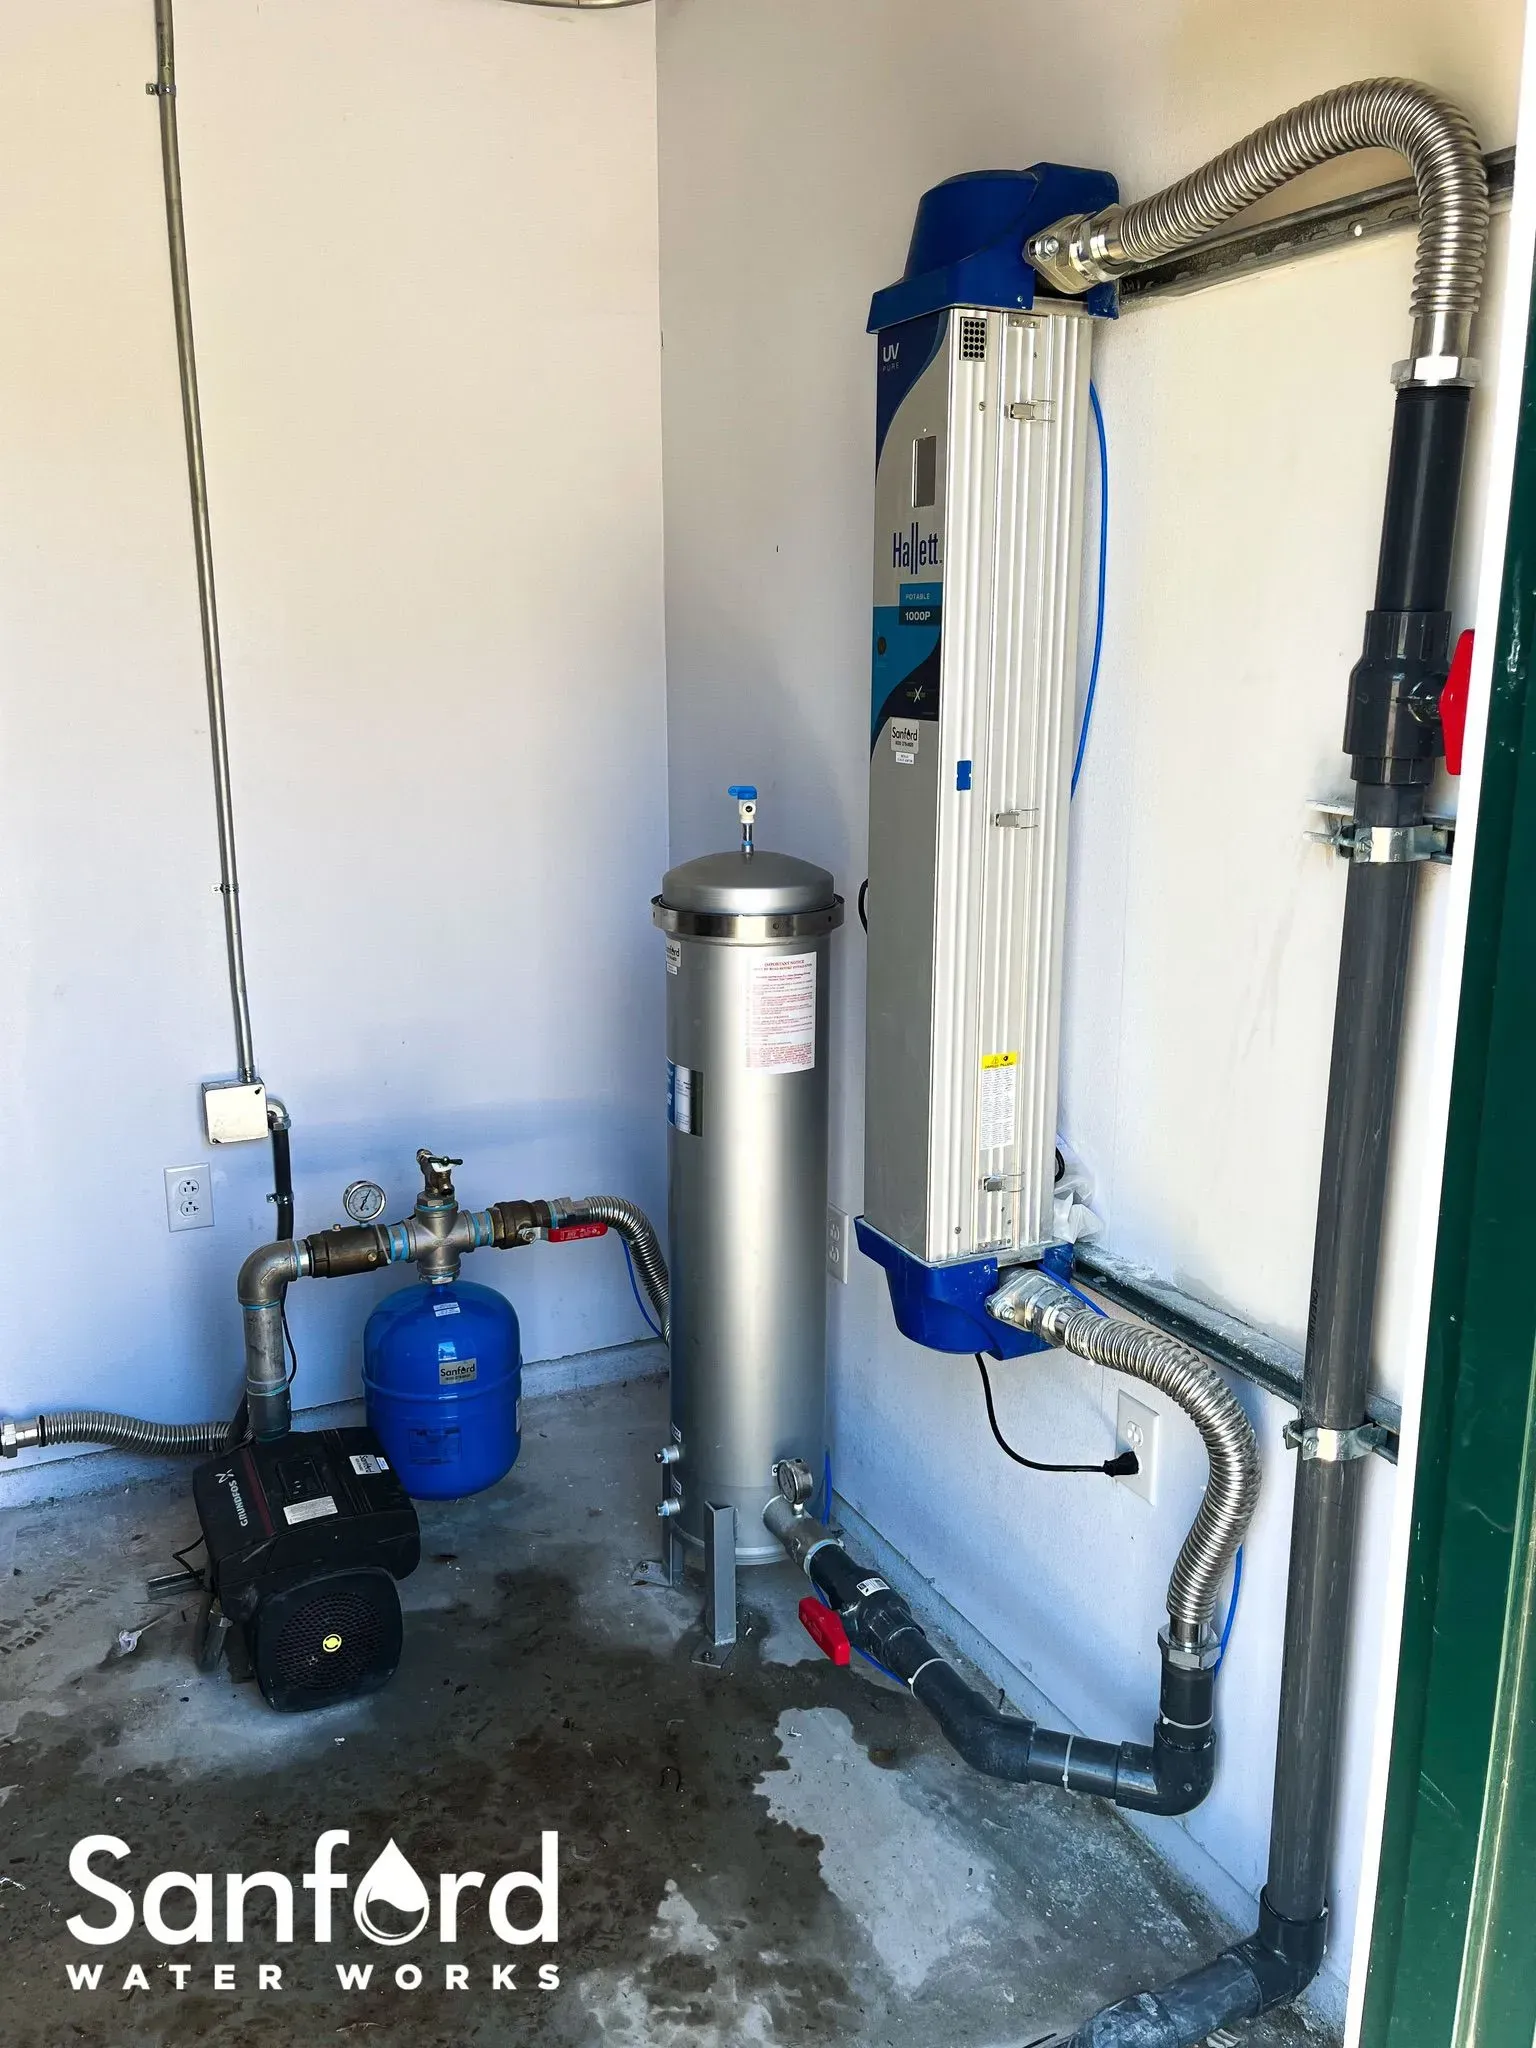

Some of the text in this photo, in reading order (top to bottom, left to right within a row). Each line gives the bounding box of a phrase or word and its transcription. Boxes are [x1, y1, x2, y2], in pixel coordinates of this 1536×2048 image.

[883, 342, 900, 362] UV
[892, 521, 939, 575] Hallett
[905, 592, 931, 600] POTABLE
[904, 611, 931, 621] 1000P
[891, 726, 918, 741] Sanford
[440, 1363, 476, 1378] Sanford
[228, 1479, 249, 1527] GRUNDFOS
